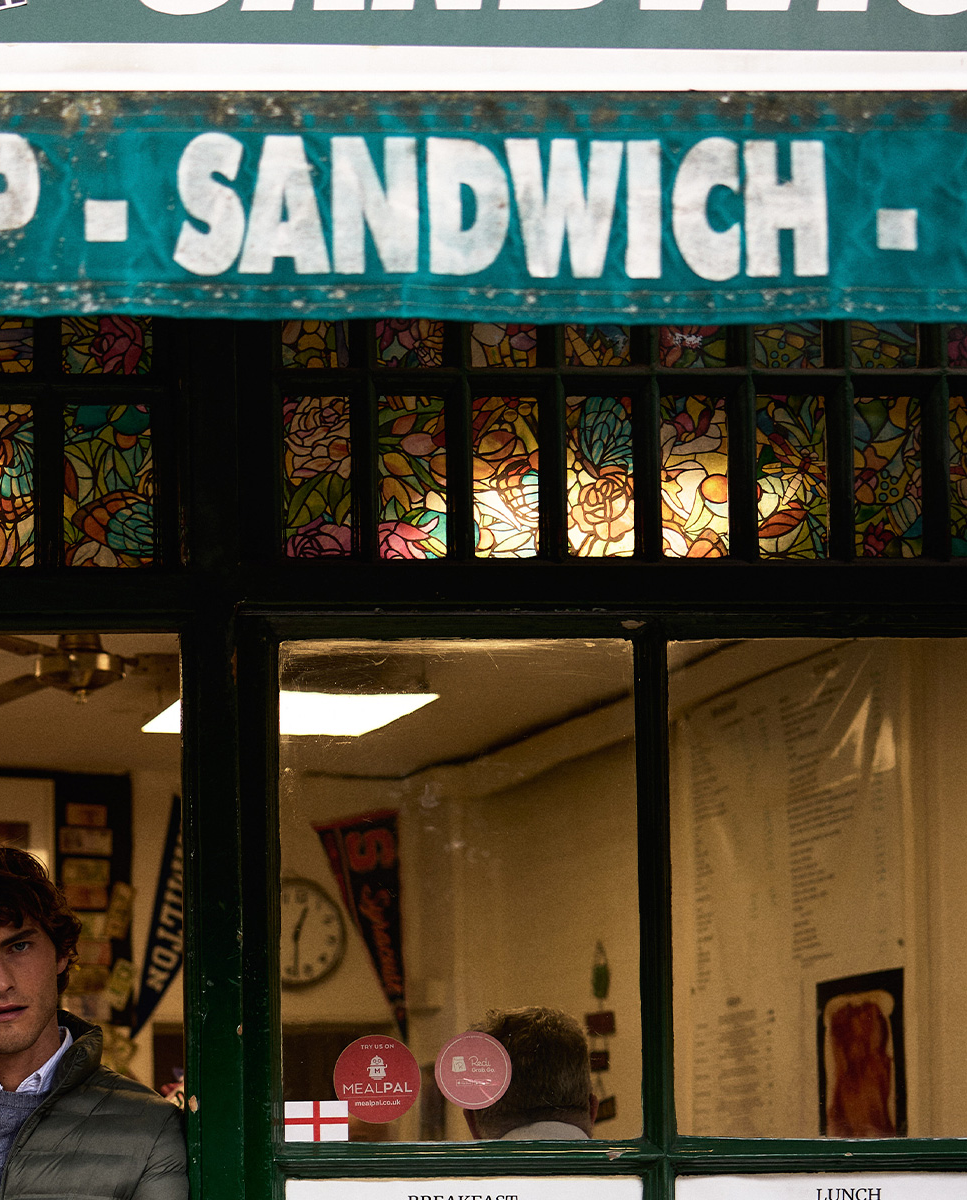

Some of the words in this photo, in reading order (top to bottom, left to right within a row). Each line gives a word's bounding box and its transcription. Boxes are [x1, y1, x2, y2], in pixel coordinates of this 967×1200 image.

[172, 132, 829, 281] SANDWICH
[343, 1082, 413, 1095] MEALPAL
[355, 1099, 401, 1107] mealpal.co.uk
